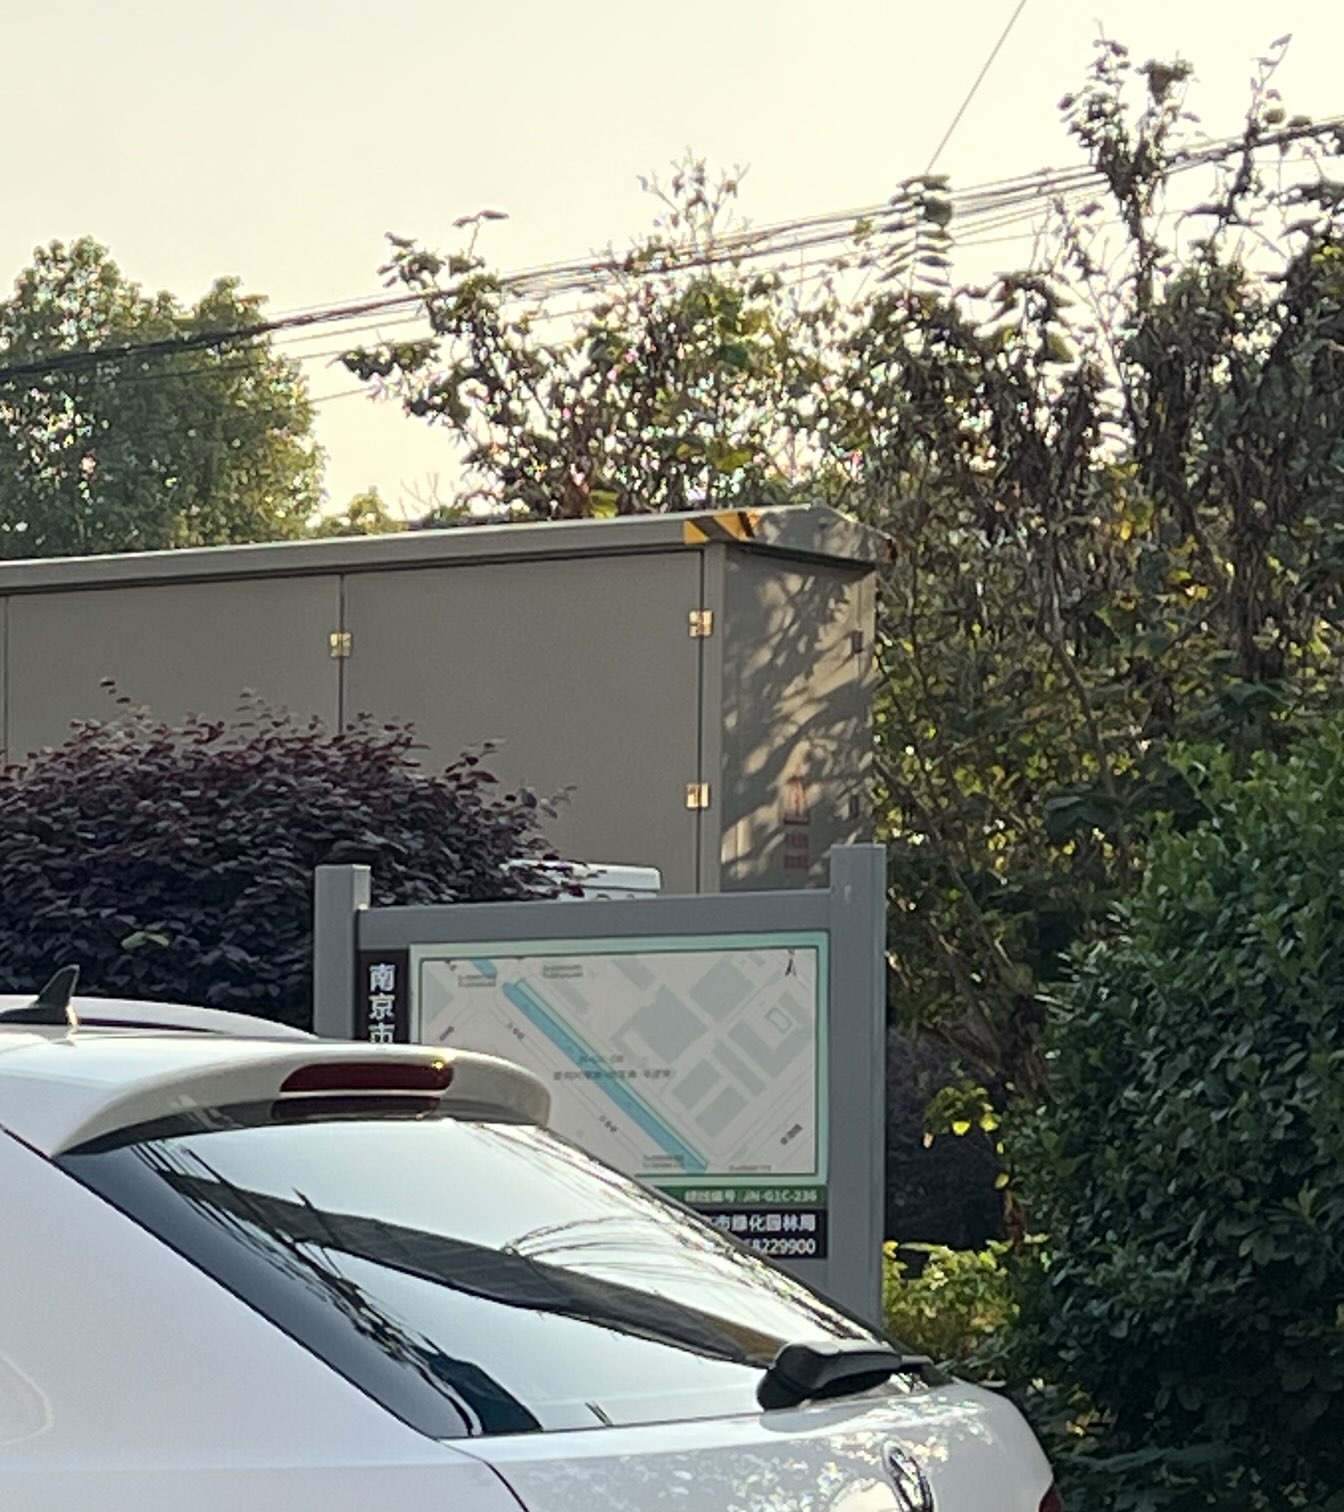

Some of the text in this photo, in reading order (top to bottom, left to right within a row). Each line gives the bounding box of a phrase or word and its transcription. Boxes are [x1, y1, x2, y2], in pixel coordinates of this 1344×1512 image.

[368, 963, 395, 1044] 南京市
[706, 1213, 816, 1232] 市绿化园林局
